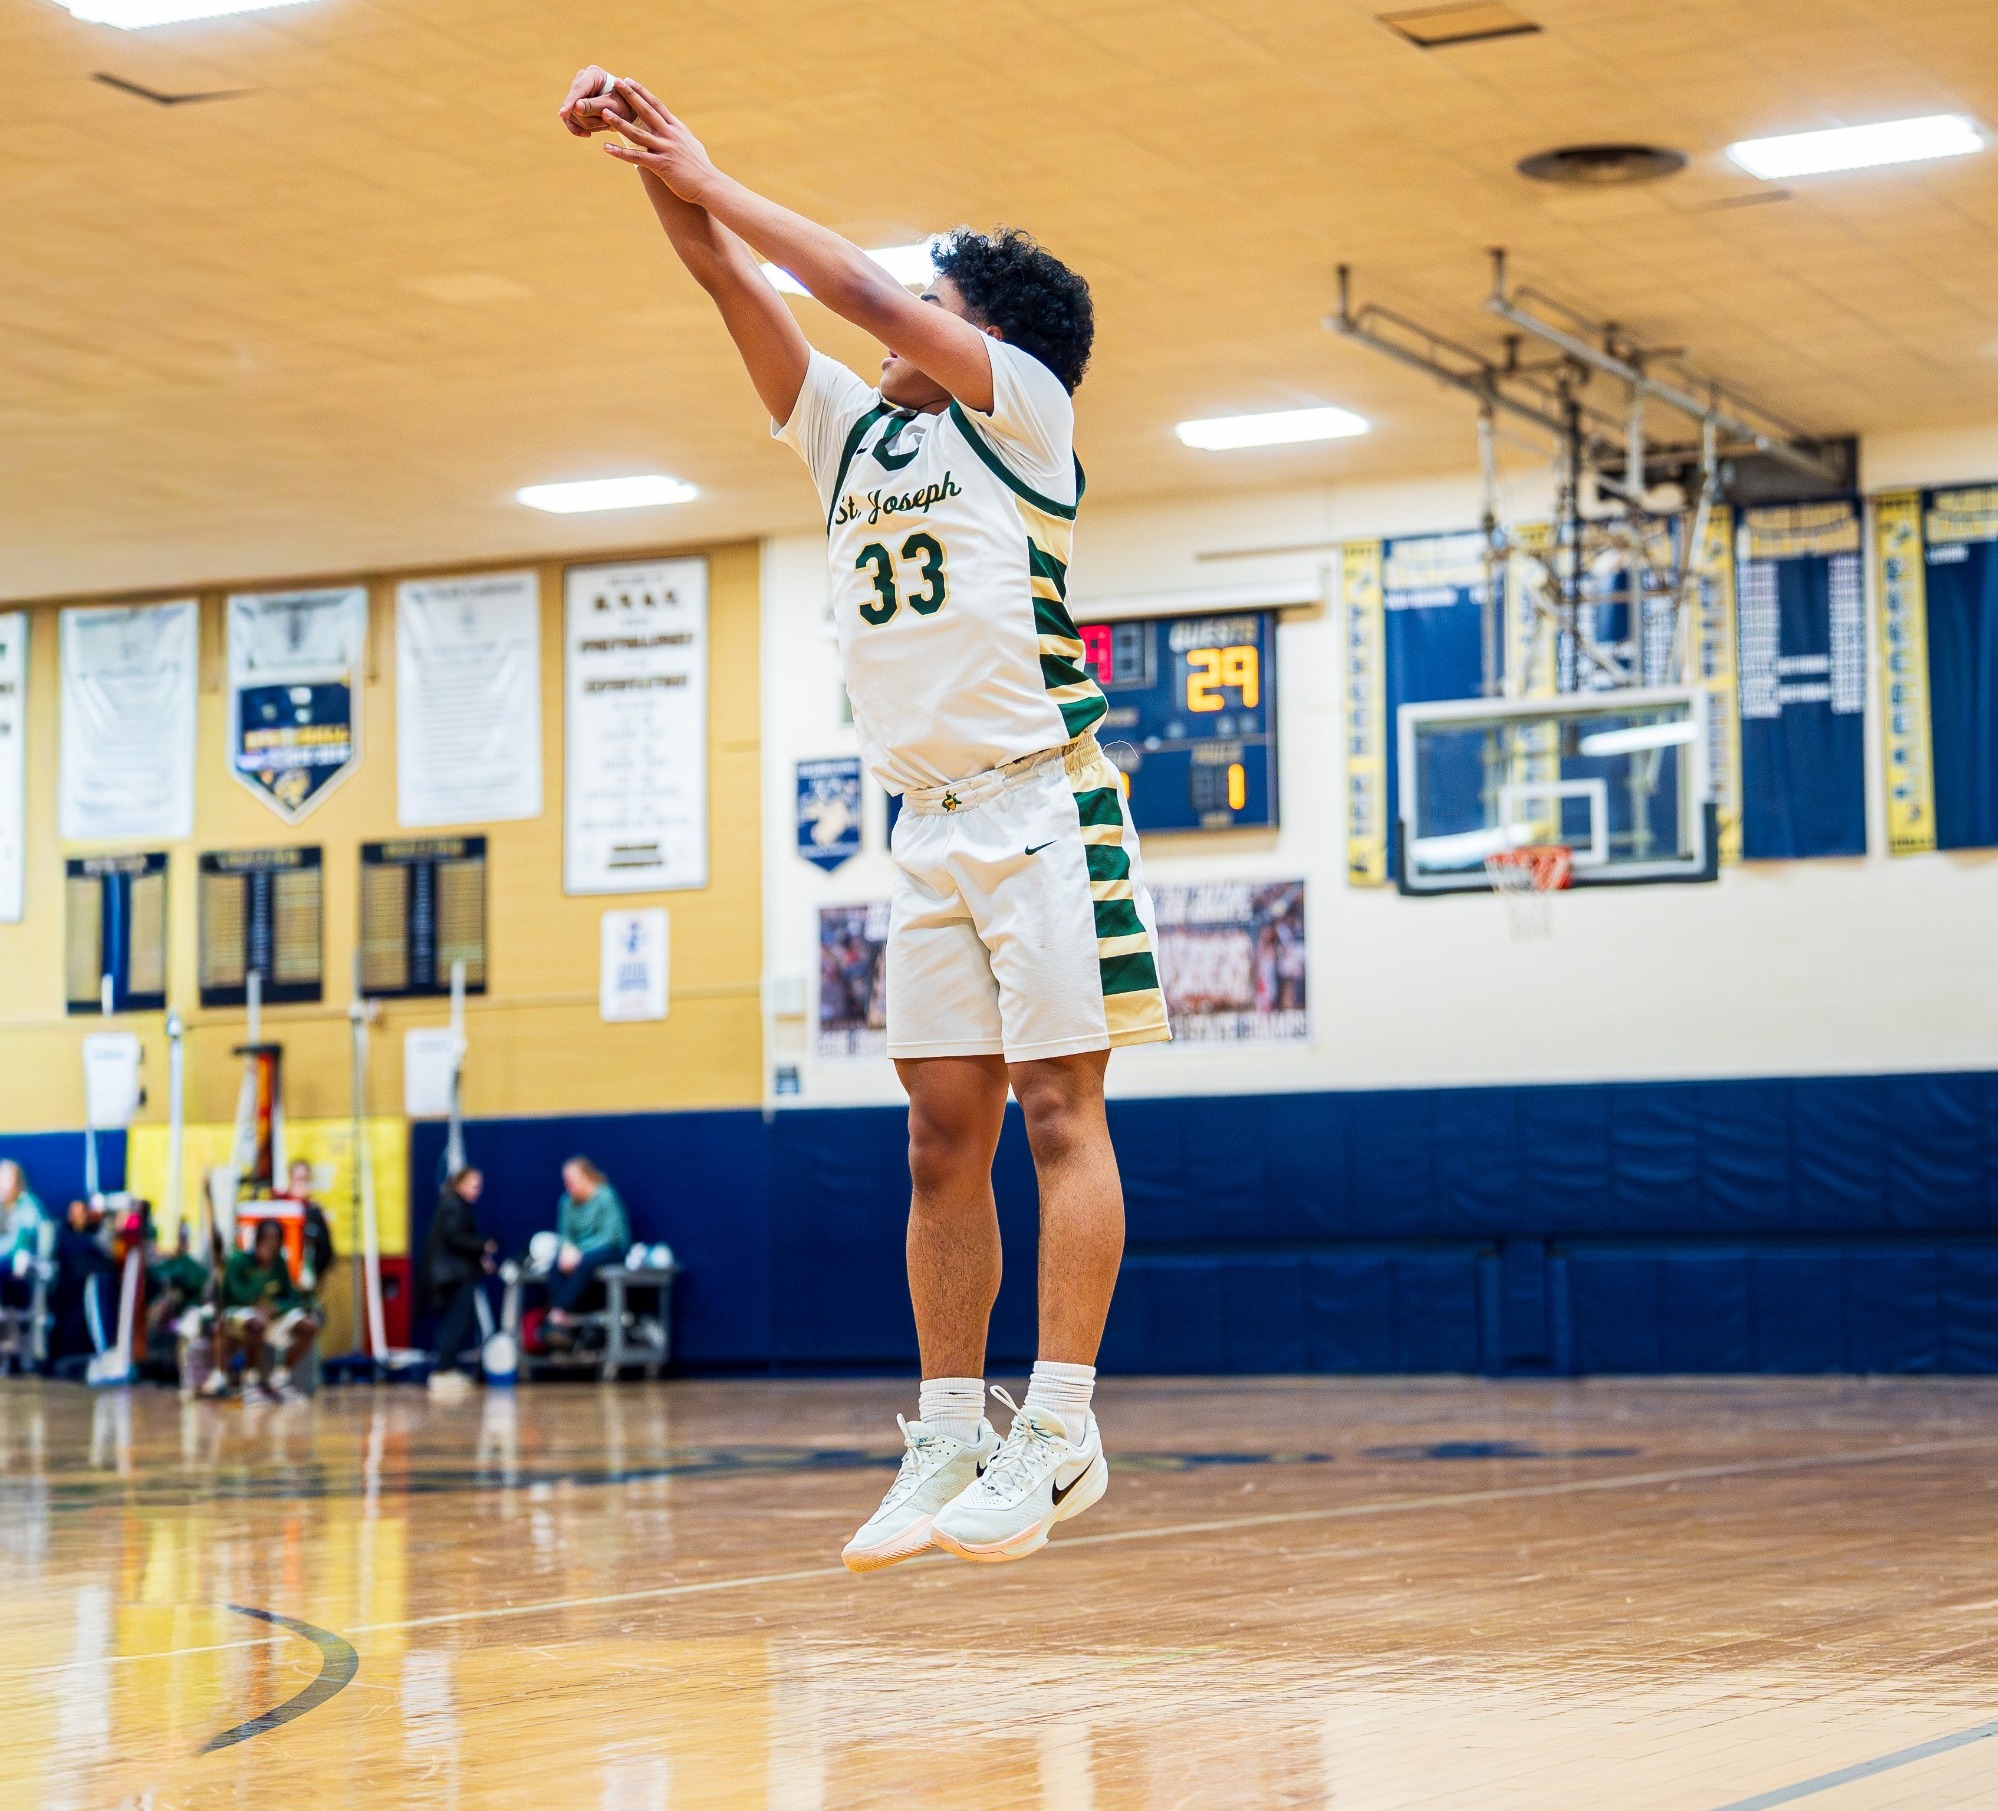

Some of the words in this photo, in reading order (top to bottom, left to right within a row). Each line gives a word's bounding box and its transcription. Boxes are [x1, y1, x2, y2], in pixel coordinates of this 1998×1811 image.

[867, 470, 962, 525] Joseph
[854, 530, 950, 629] 33
[1186, 645, 1259, 713] 29
[1227, 763, 1245, 810] 1
